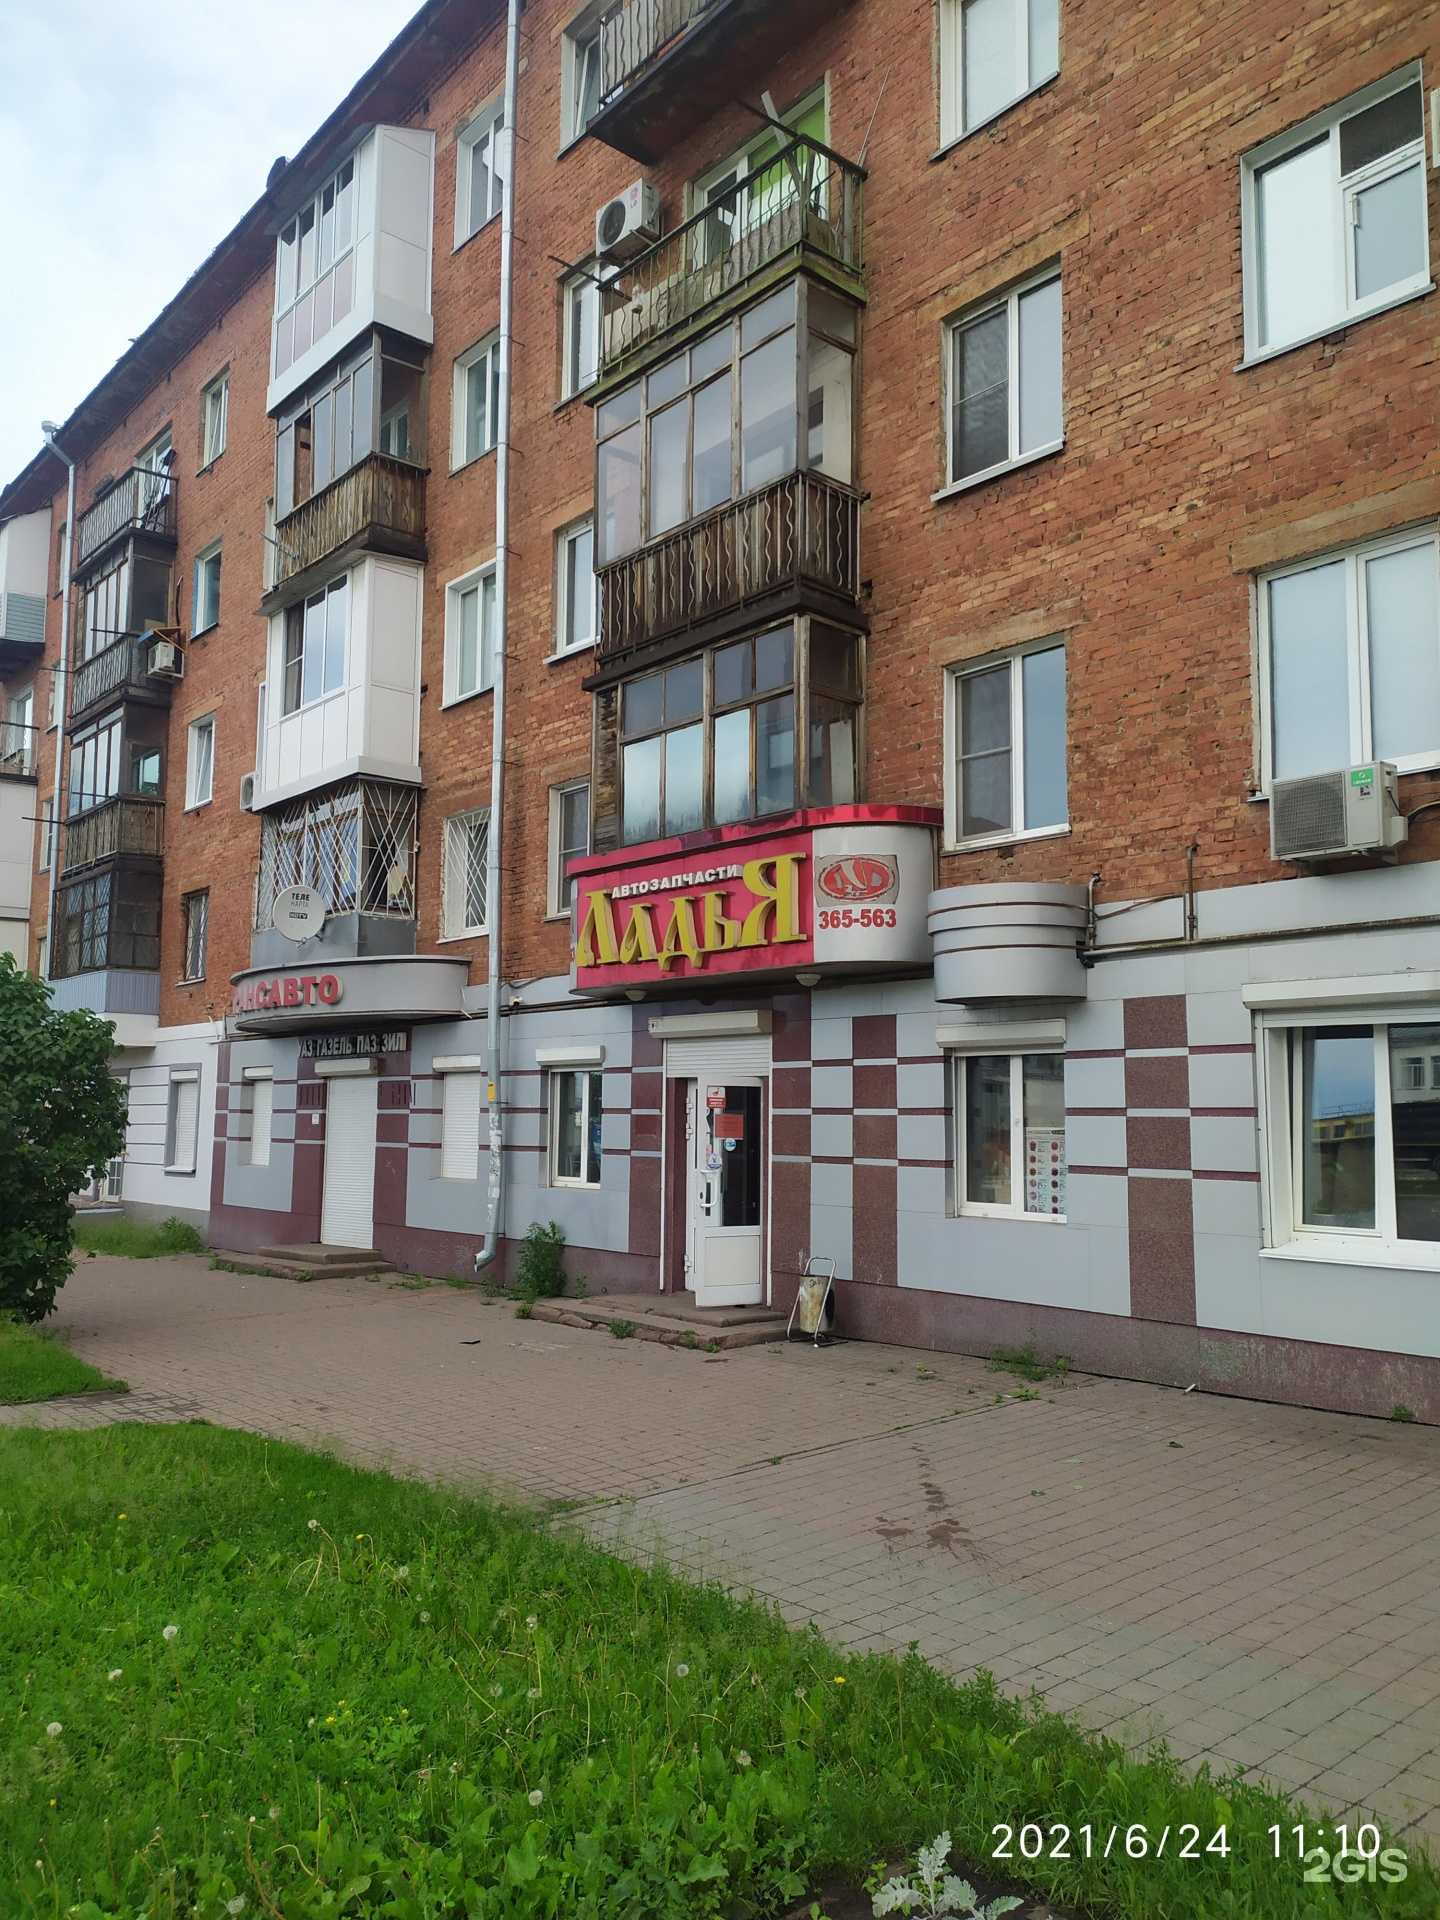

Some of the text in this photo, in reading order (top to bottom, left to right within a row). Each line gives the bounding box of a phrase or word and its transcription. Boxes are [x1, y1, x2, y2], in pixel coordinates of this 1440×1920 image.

[612, 864, 741, 899] АВТОЗАПЧАСТИ
[292, 893, 310, 901] ТЕЛЕ
[818, 908, 897, 929] 365-563
[316, 1036, 352, 1056] ГАЗЕЛЬ
[356, 1034, 377, 1053] ПАЗ
[381, 1032, 407, 1051] ЗИЛ
